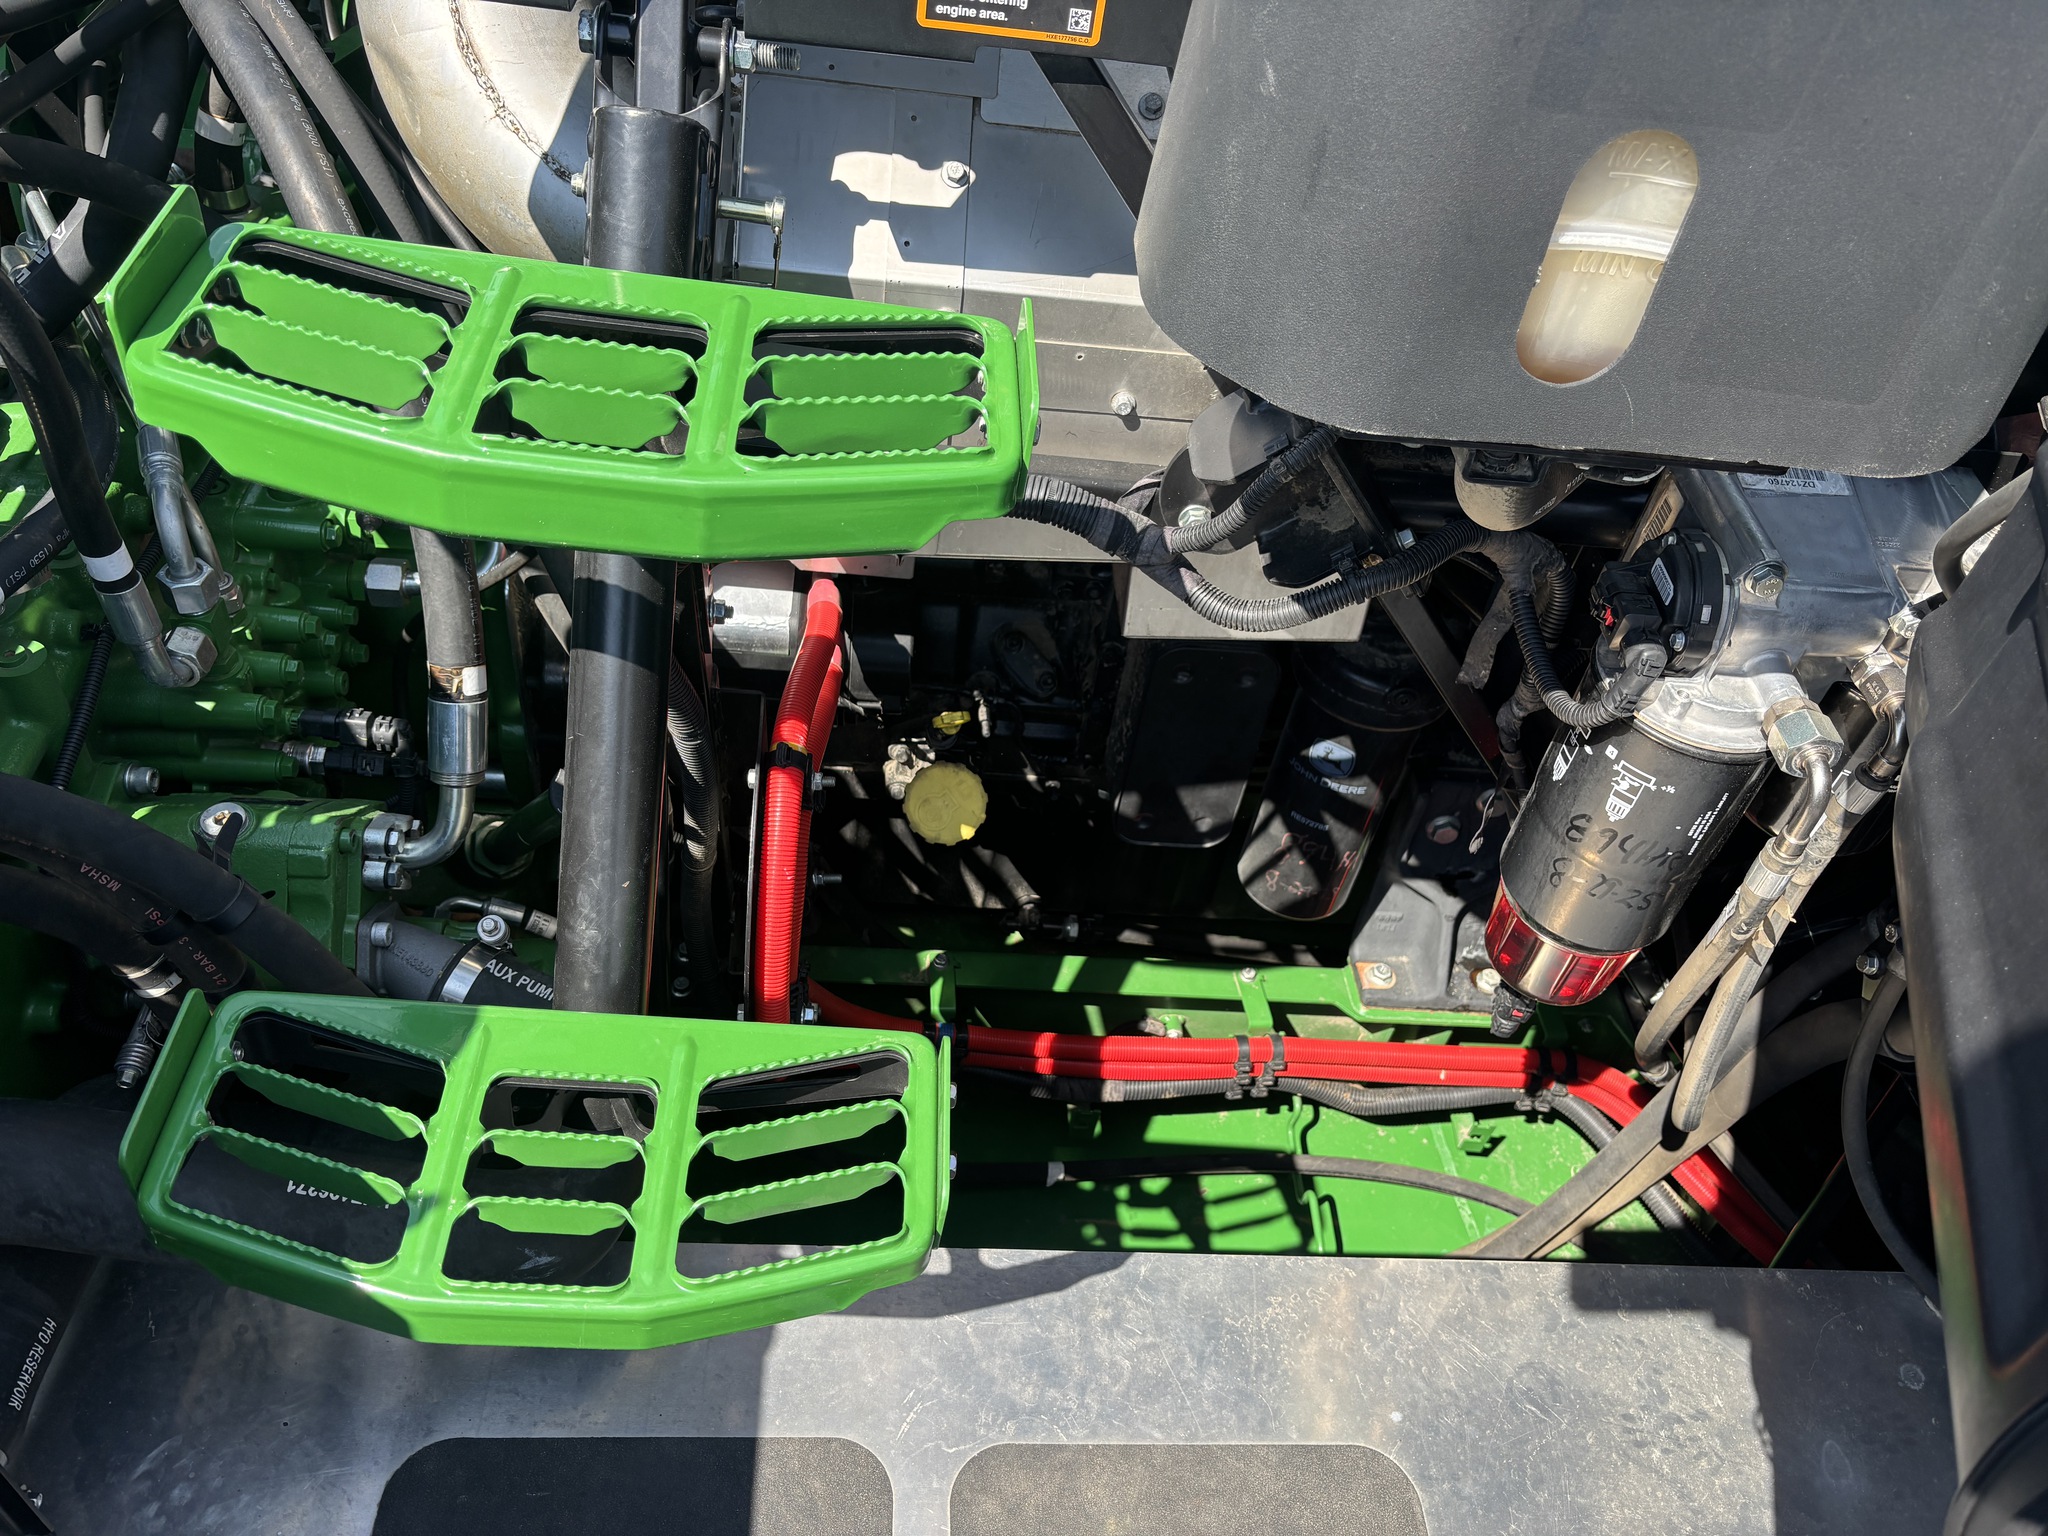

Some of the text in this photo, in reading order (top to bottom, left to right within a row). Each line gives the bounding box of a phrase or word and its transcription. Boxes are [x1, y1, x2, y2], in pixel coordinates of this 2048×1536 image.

[935, 4, 1009, 22] engine area.
[300, 118, 321, 148] (3000
[316, 152, 335, 178] PSI)
[1607, 141, 1690, 171] MAX
[1572, 252, 1639, 278] MIN
[1768, 477, 1816, 489] DZ124760
[29, 543, 54, 568] (1530
[5, 566, 27, 588] PSI)
[1288, 756, 1368, 795] JOHN DEERE
[80, 862, 122, 892] MSHA
[144, 907, 167, 927] PSI
[192, 950, 217, 974] BAR
[484, 958, 519, 984] AUX
[211, 972, 227, 986] 21
[8, 1317, 58, 1411] HYD RESERVOIR
